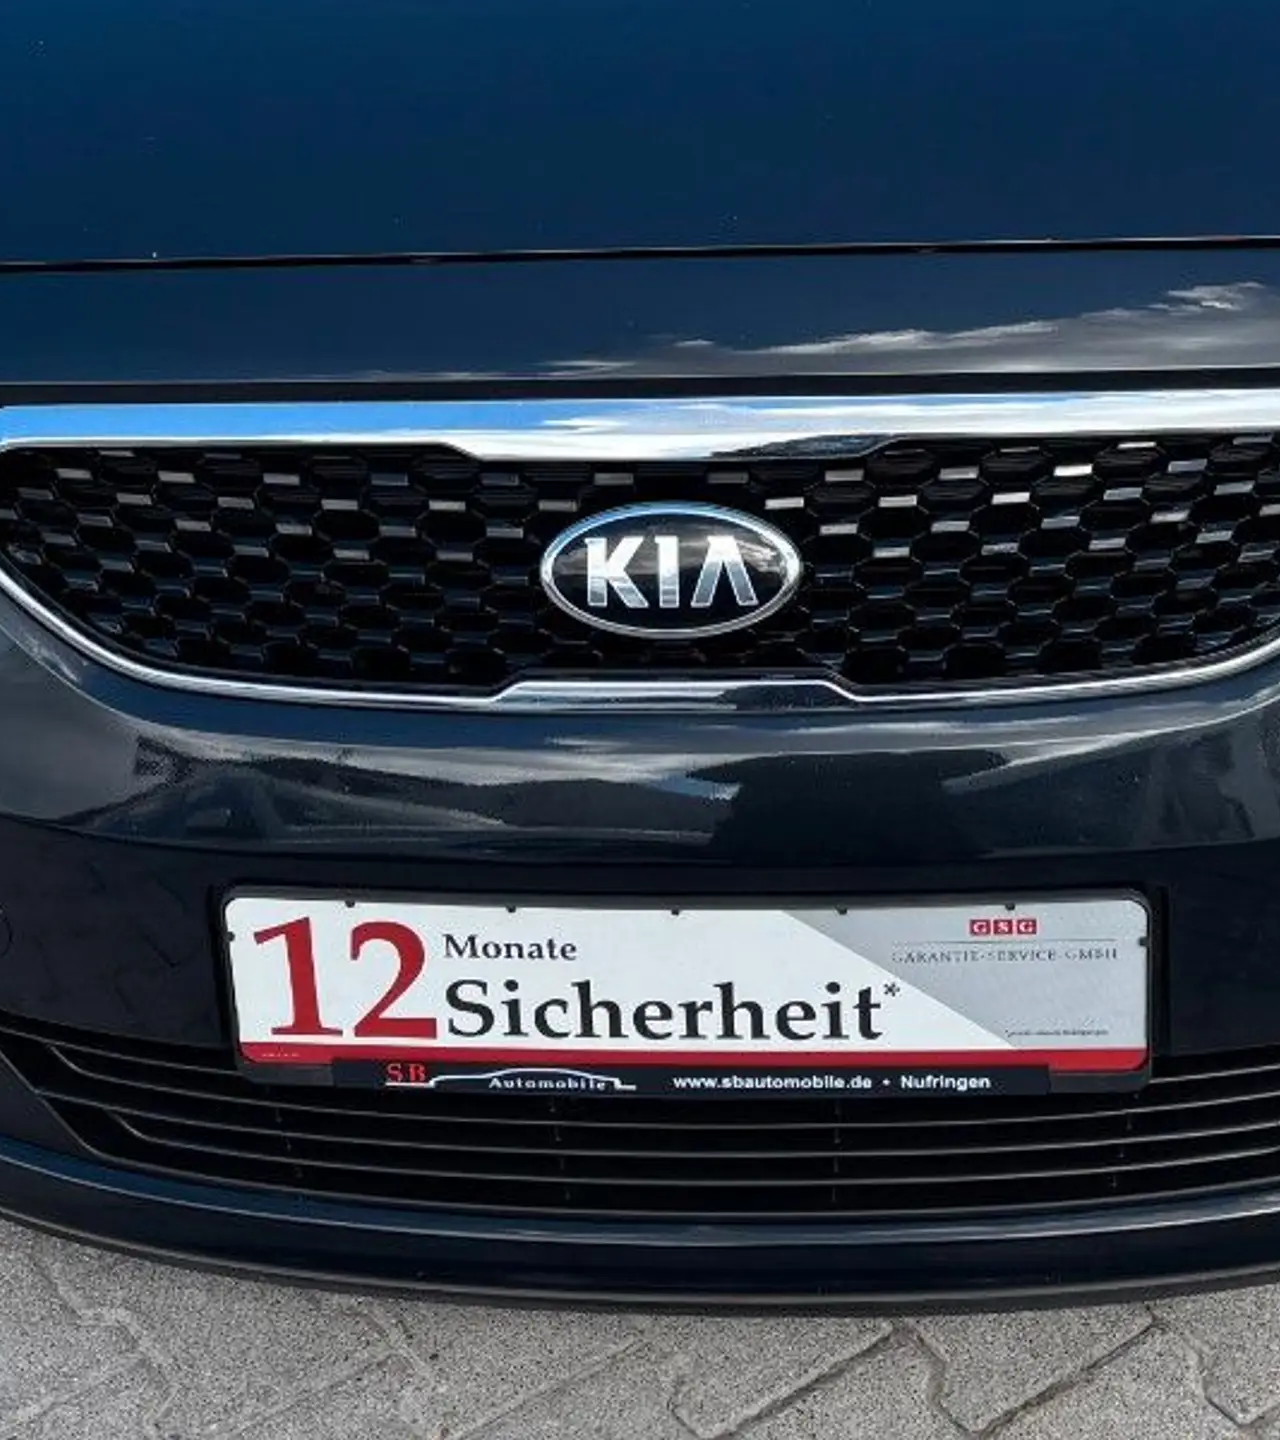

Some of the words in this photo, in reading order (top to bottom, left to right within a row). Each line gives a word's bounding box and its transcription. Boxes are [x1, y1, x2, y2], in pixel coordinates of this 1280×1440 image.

[584, 535, 759, 608] KIA
[971, 920, 1036, 934] GSG
[254, 917, 437, 1039] 12
[442, 934, 578, 961] Monate
[386, 1062, 426, 1082] SB
[488, 1076, 607, 1091] Automobile
[673, 1075, 872, 1089] www.sbautomobile.de
[901, 1075, 991, 1092] Nufringen
